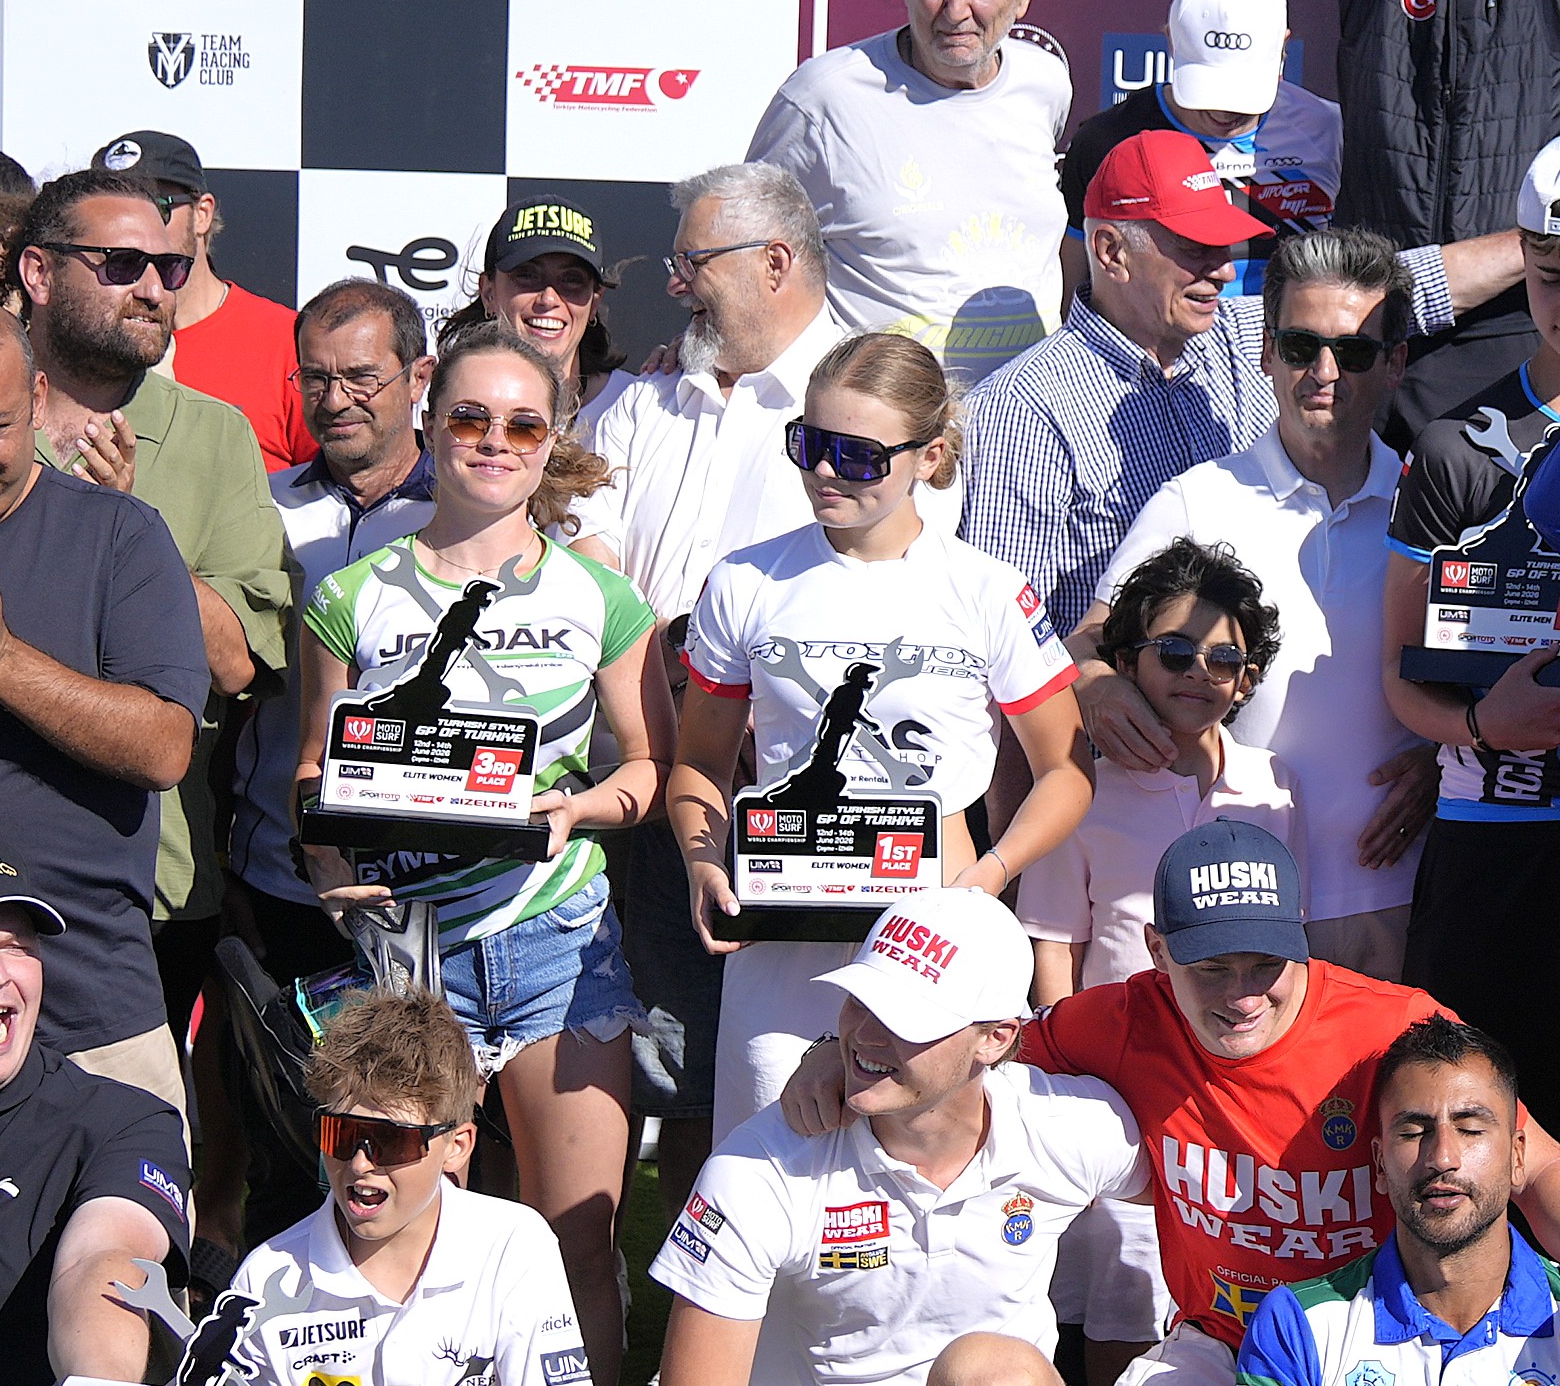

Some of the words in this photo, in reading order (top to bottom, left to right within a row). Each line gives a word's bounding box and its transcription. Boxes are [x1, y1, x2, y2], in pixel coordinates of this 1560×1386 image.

[200, 33, 242, 52] TEAM
[199, 51, 251, 71] RACING
[198, 68, 235, 87] CLUB
[570, 69, 645, 97] TMF
[1216, 160, 1253, 172] Brno
[512, 204, 594, 241] JETSURF
[476, 752, 517, 777] 3RD
[402, 771, 426, 780] ELITE
[428, 773, 463, 783] WOMEN
[475, 776, 507, 787] PLACE
[878, 836, 917, 860] 1ST
[811, 861, 836, 870] ELITE
[837, 862, 871, 870] WOMEN
[881, 860, 912, 871] PLACE
[1189, 861, 1279, 895] HUSKI
[1192, 888, 1281, 910] WEAR
[880, 914, 959, 970] HUSKI
[871, 938, 942, 986] WEAR
[1324, 1122, 1354, 1137] KMK
[1336, 1135, 1346, 1145] R
[1163, 1135, 1374, 1226] HUSKI
[825, 1204, 883, 1230] HUSKI
[673, 1224, 697, 1249] UIM
[823, 1222, 885, 1241] WEAR
[1013, 1230, 1023, 1241] R
[1171, 1196, 1378, 1261] WEAR
[859, 1254, 888, 1269] SWE
[1216, 1264, 1269, 1285] OFFICIAL
[301, 1318, 368, 1347] JETSURF
[292, 1352, 340, 1371] CRAFT
